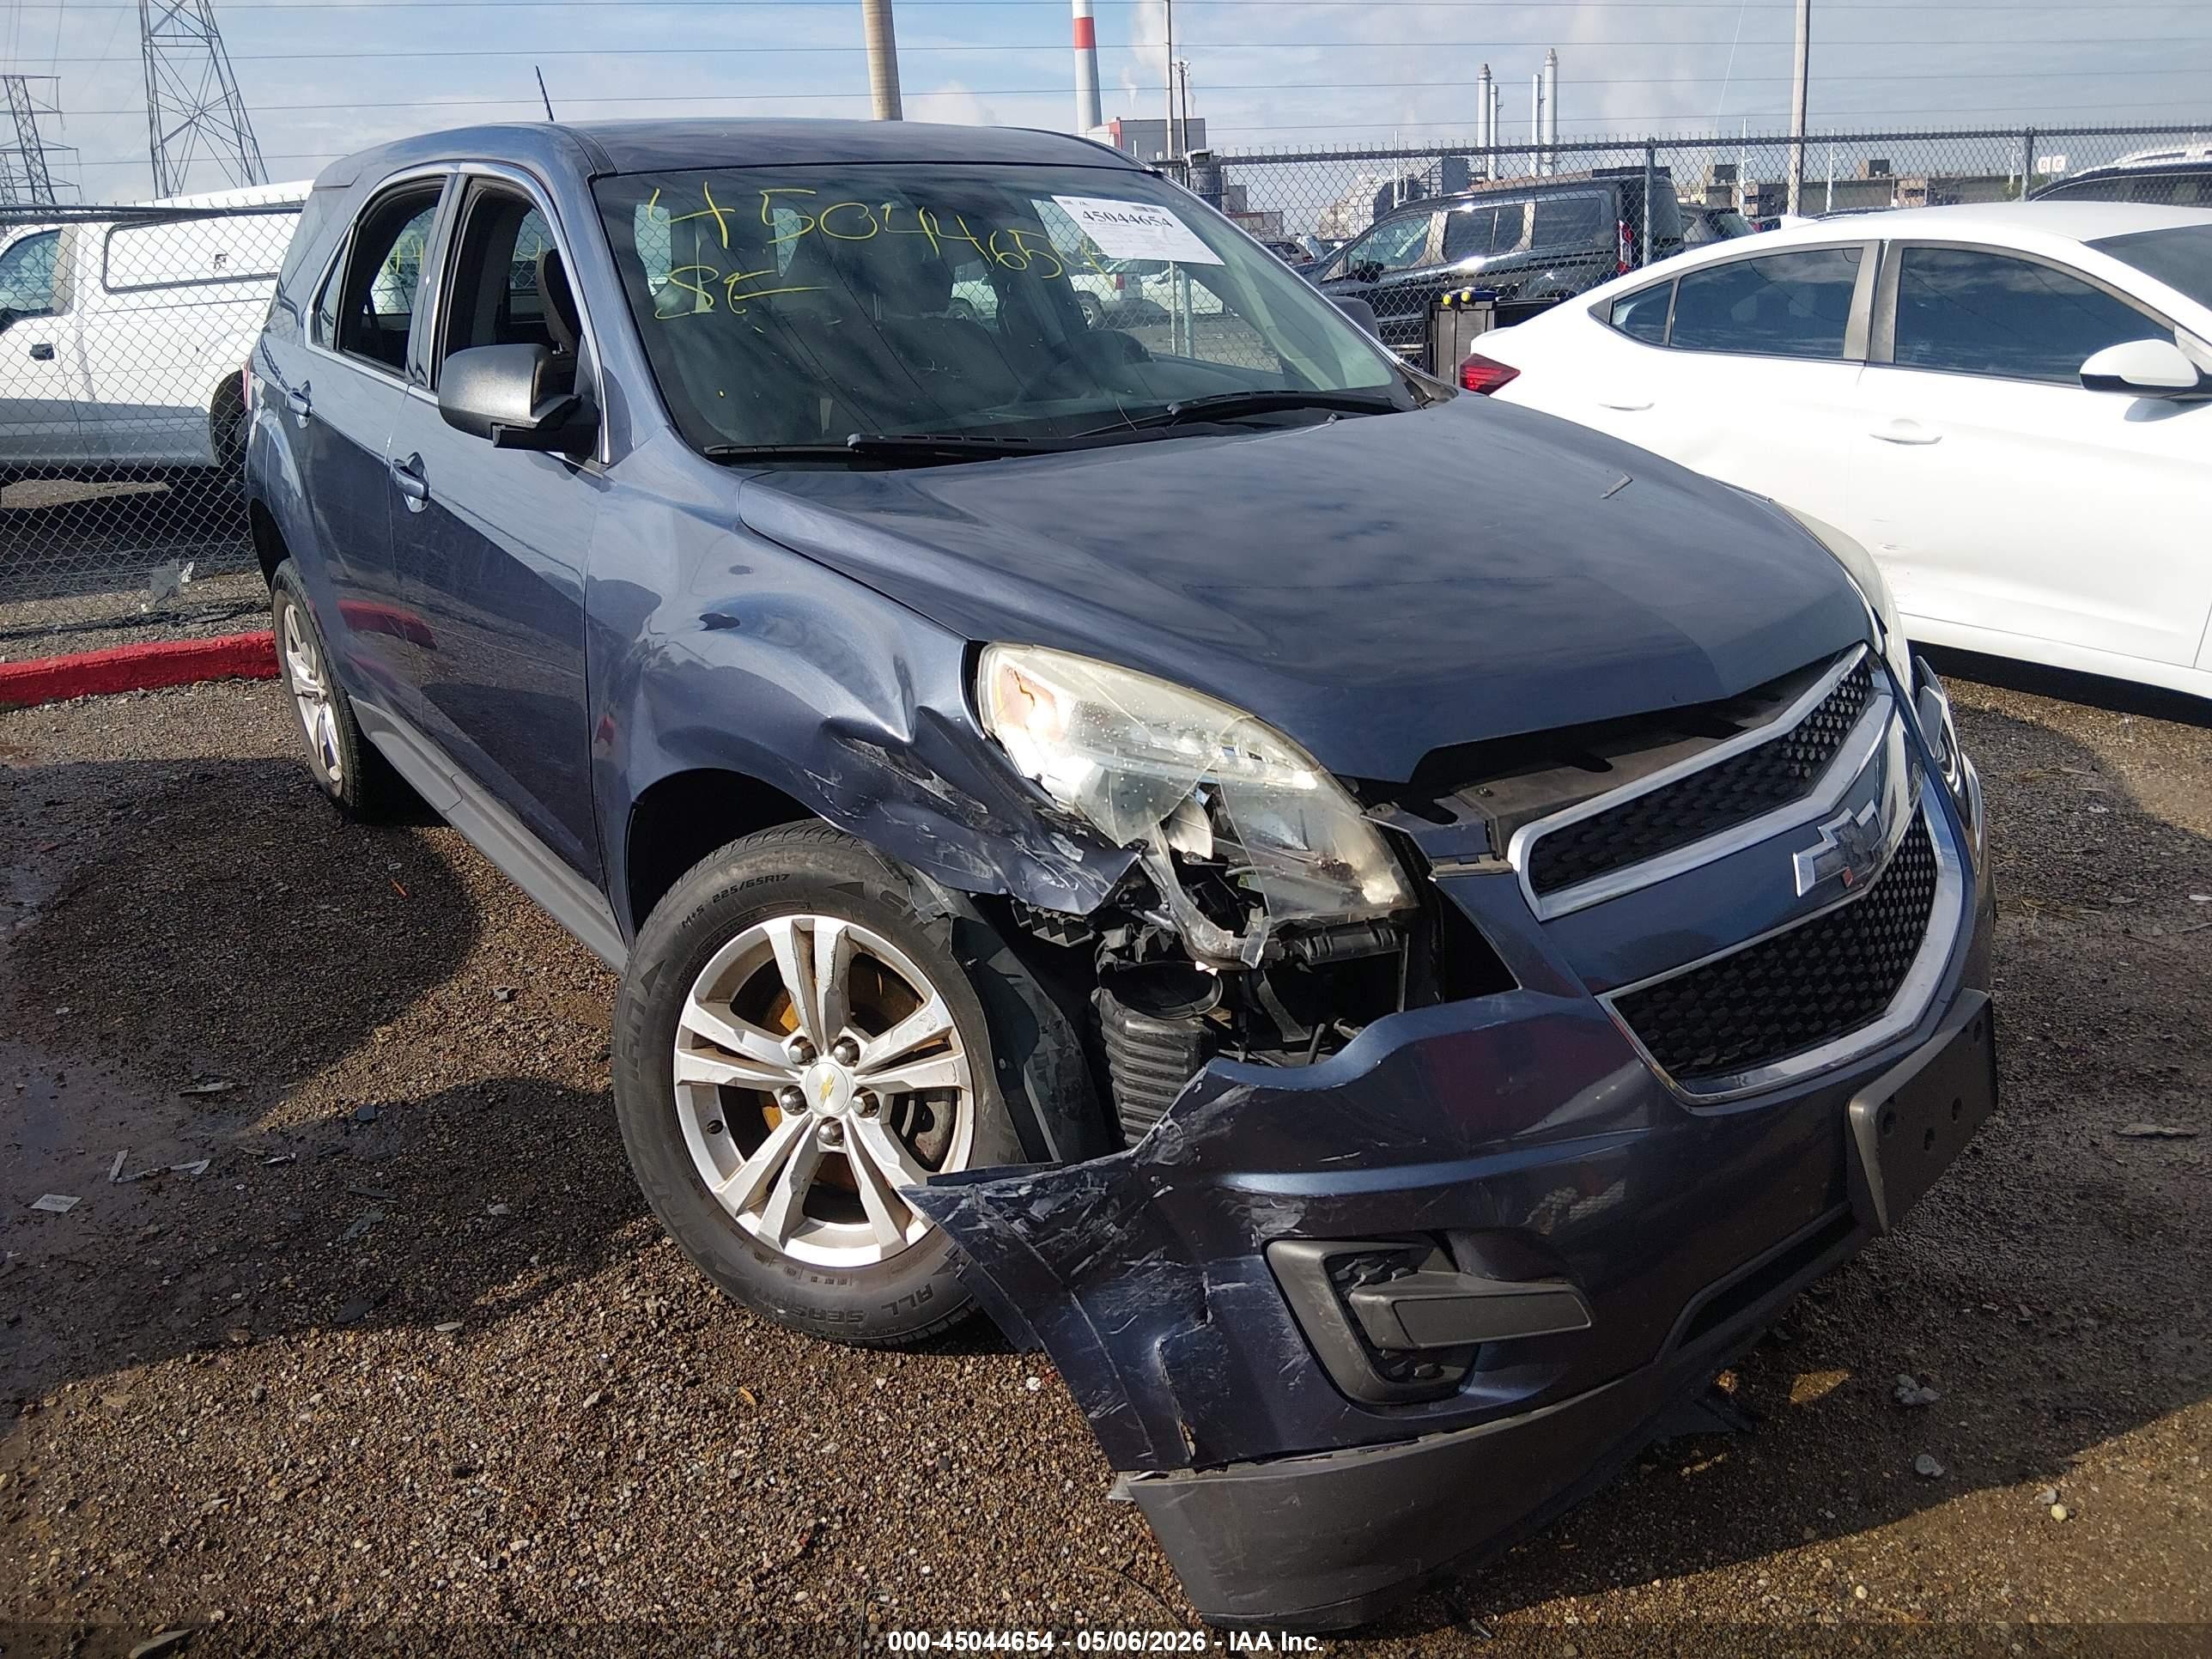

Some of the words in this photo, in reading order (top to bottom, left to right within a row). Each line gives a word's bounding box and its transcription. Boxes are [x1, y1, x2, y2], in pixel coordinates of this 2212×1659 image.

[1082, 209, 1174, 229] 45044654
[712, 873, 791, 904] 225/65R17
[880, 1283, 934, 1316] ALL
